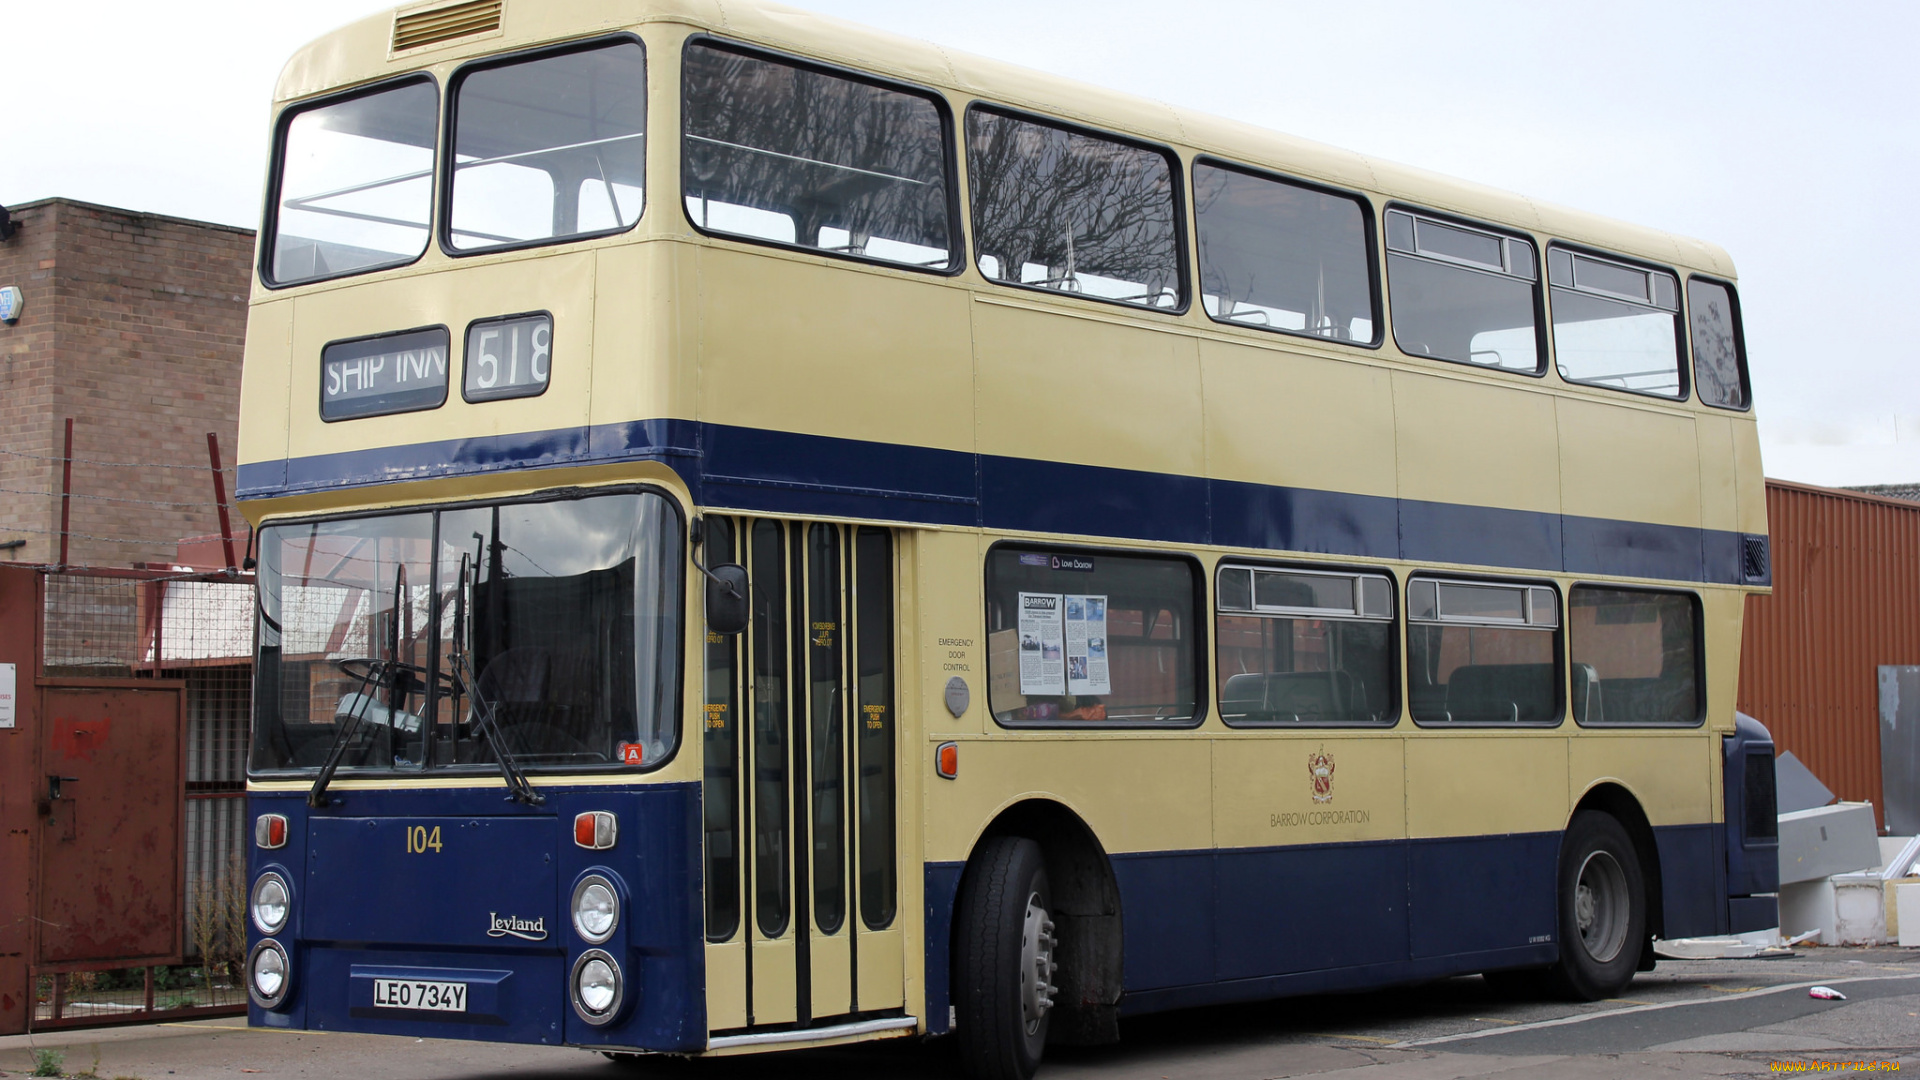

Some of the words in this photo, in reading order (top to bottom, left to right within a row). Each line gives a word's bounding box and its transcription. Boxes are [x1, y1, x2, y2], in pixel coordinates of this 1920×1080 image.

[476, 323, 550, 389] 518
[327, 355, 385, 396] SHIP
[395, 347, 446, 384] INN
[1073, 559, 1093, 569] Barrow
[1024, 597, 1056, 608] BARROW
[938, 637, 974, 647] EMERGENCY
[948, 650, 966, 659] DOOR
[943, 663, 971, 672] CONTROL
[863, 704, 885, 713] EMERGENCY
[628, 749, 639, 760] A
[1270, 812, 1308, 828] BARROW
[1308, 809, 1370, 826] CORPORATION
[407, 825, 443, 854] 104
[488, 912, 547, 940] Leyland
[375, 982, 411, 1005] LEO
[415, 984, 465, 1009] 734Y
